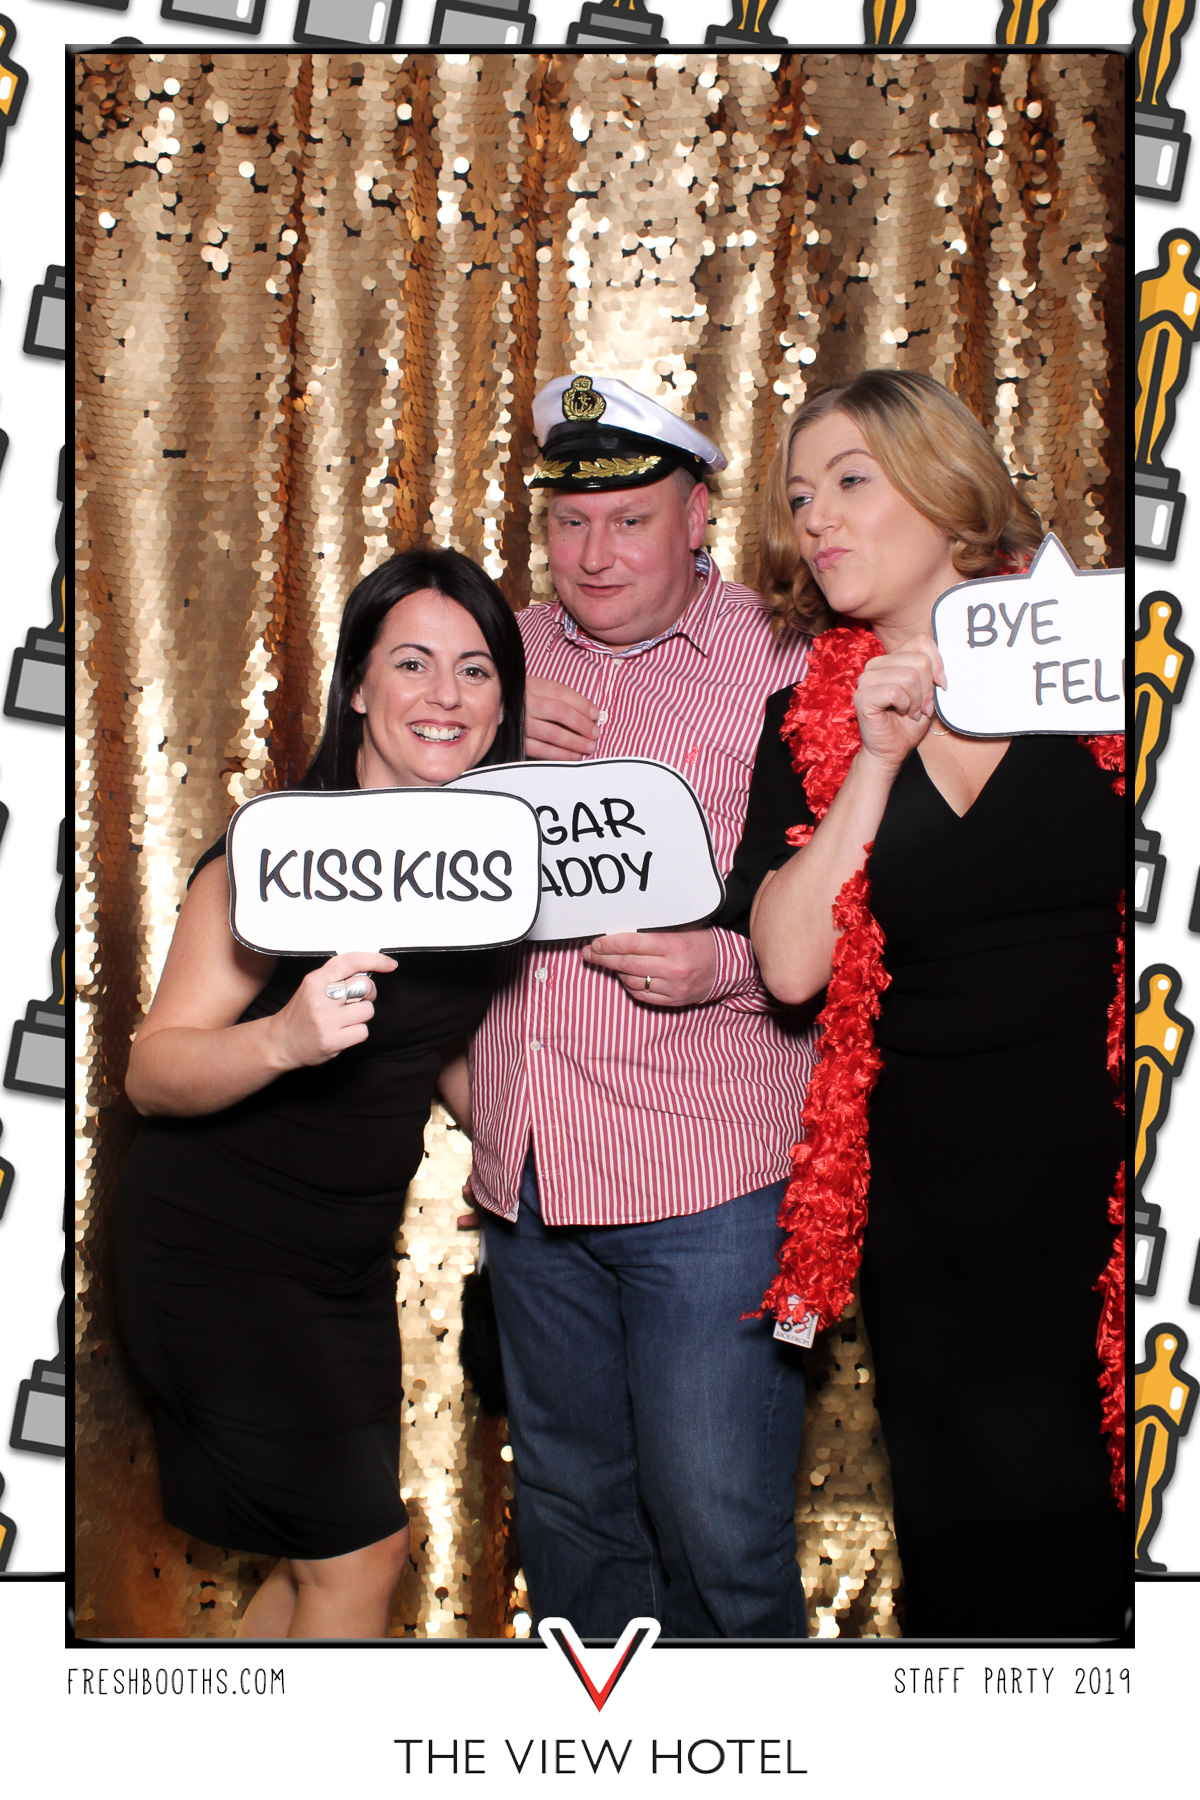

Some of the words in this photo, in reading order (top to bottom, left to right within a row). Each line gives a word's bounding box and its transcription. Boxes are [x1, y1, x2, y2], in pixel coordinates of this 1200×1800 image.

[967, 598, 1062, 649] BYE
[1033, 657, 1125, 706] FEL
[536, 798, 646, 846] GAR
[259, 848, 382, 903] KISS
[393, 849, 513, 903] KISS
